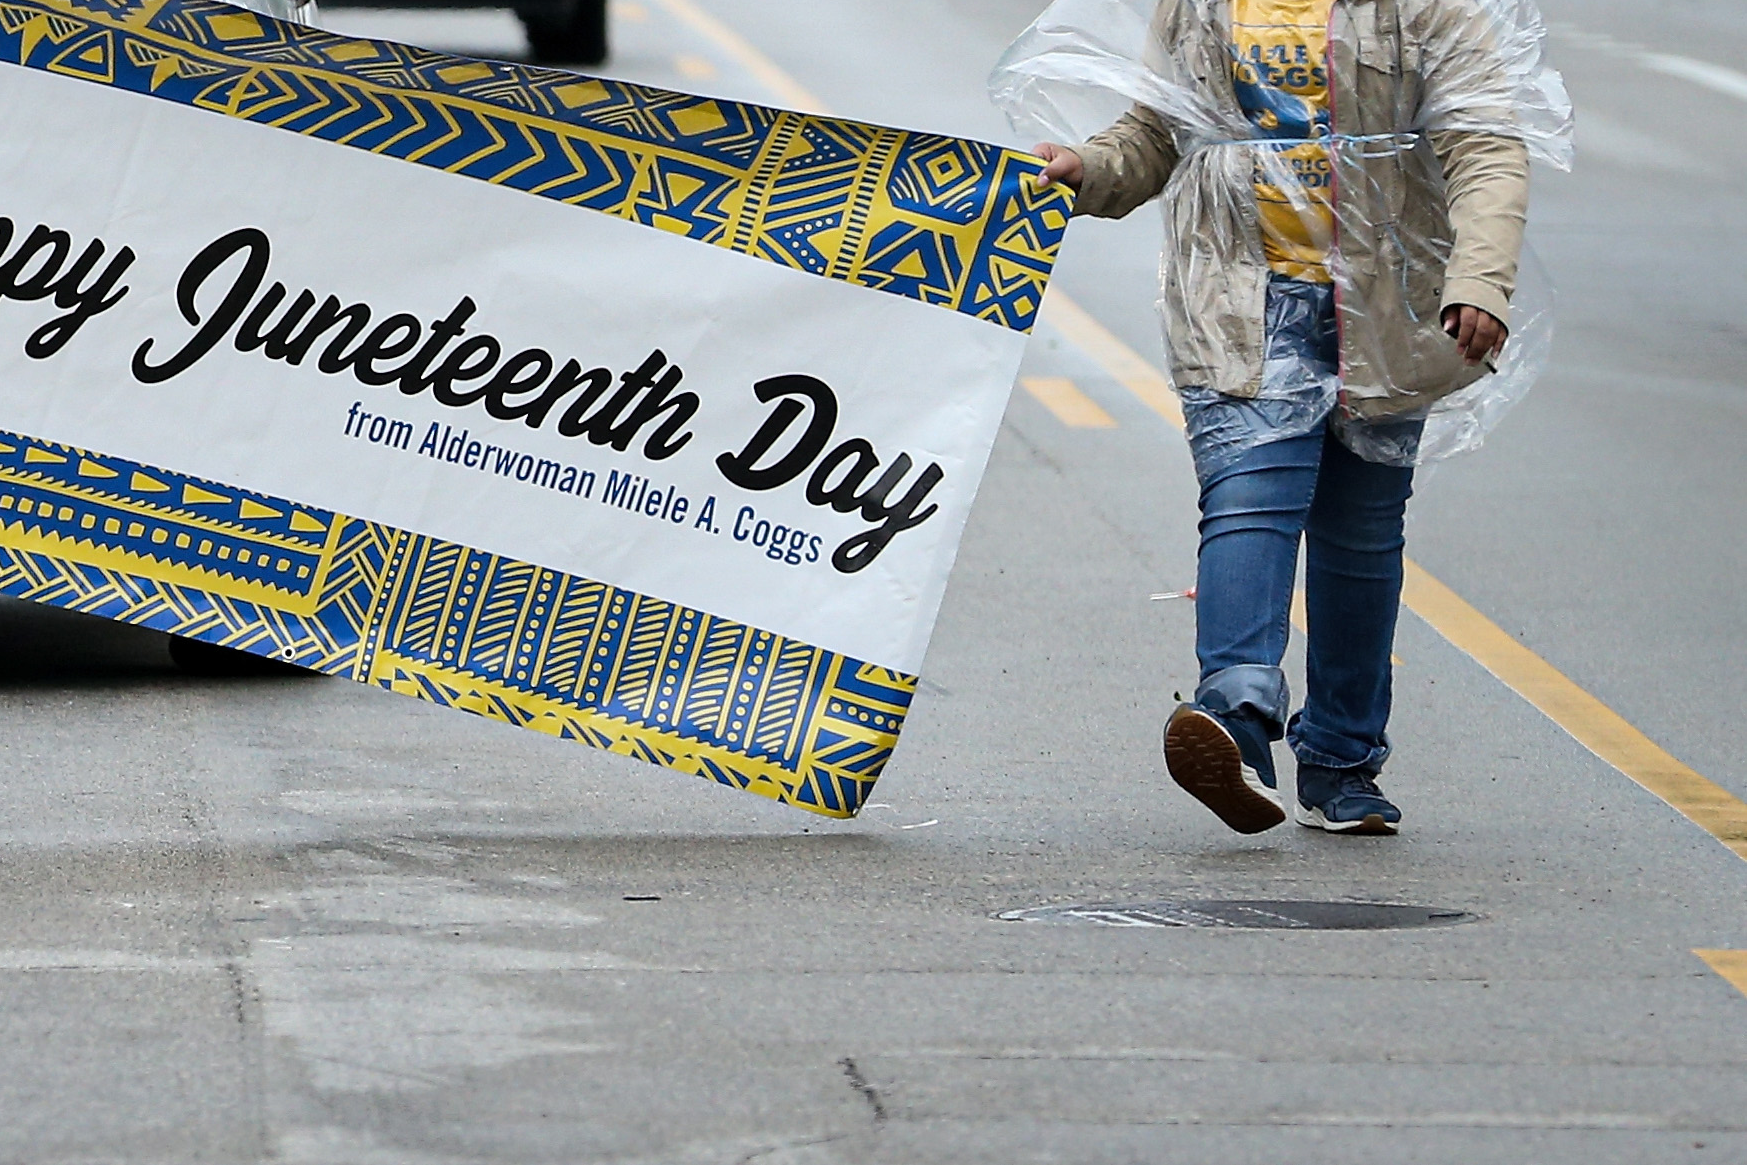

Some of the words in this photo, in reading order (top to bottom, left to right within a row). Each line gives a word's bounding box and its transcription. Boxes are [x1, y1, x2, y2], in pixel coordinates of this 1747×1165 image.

[130, 227, 701, 461] Juneteenth
[714, 373, 945, 575] Day
[343, 401, 415, 451] from
[418, 421, 597, 501] Alderwoman
[600, 468, 689, 526] Milele
[693, 495, 721, 536] A.
[731, 504, 825, 566] Coggs
